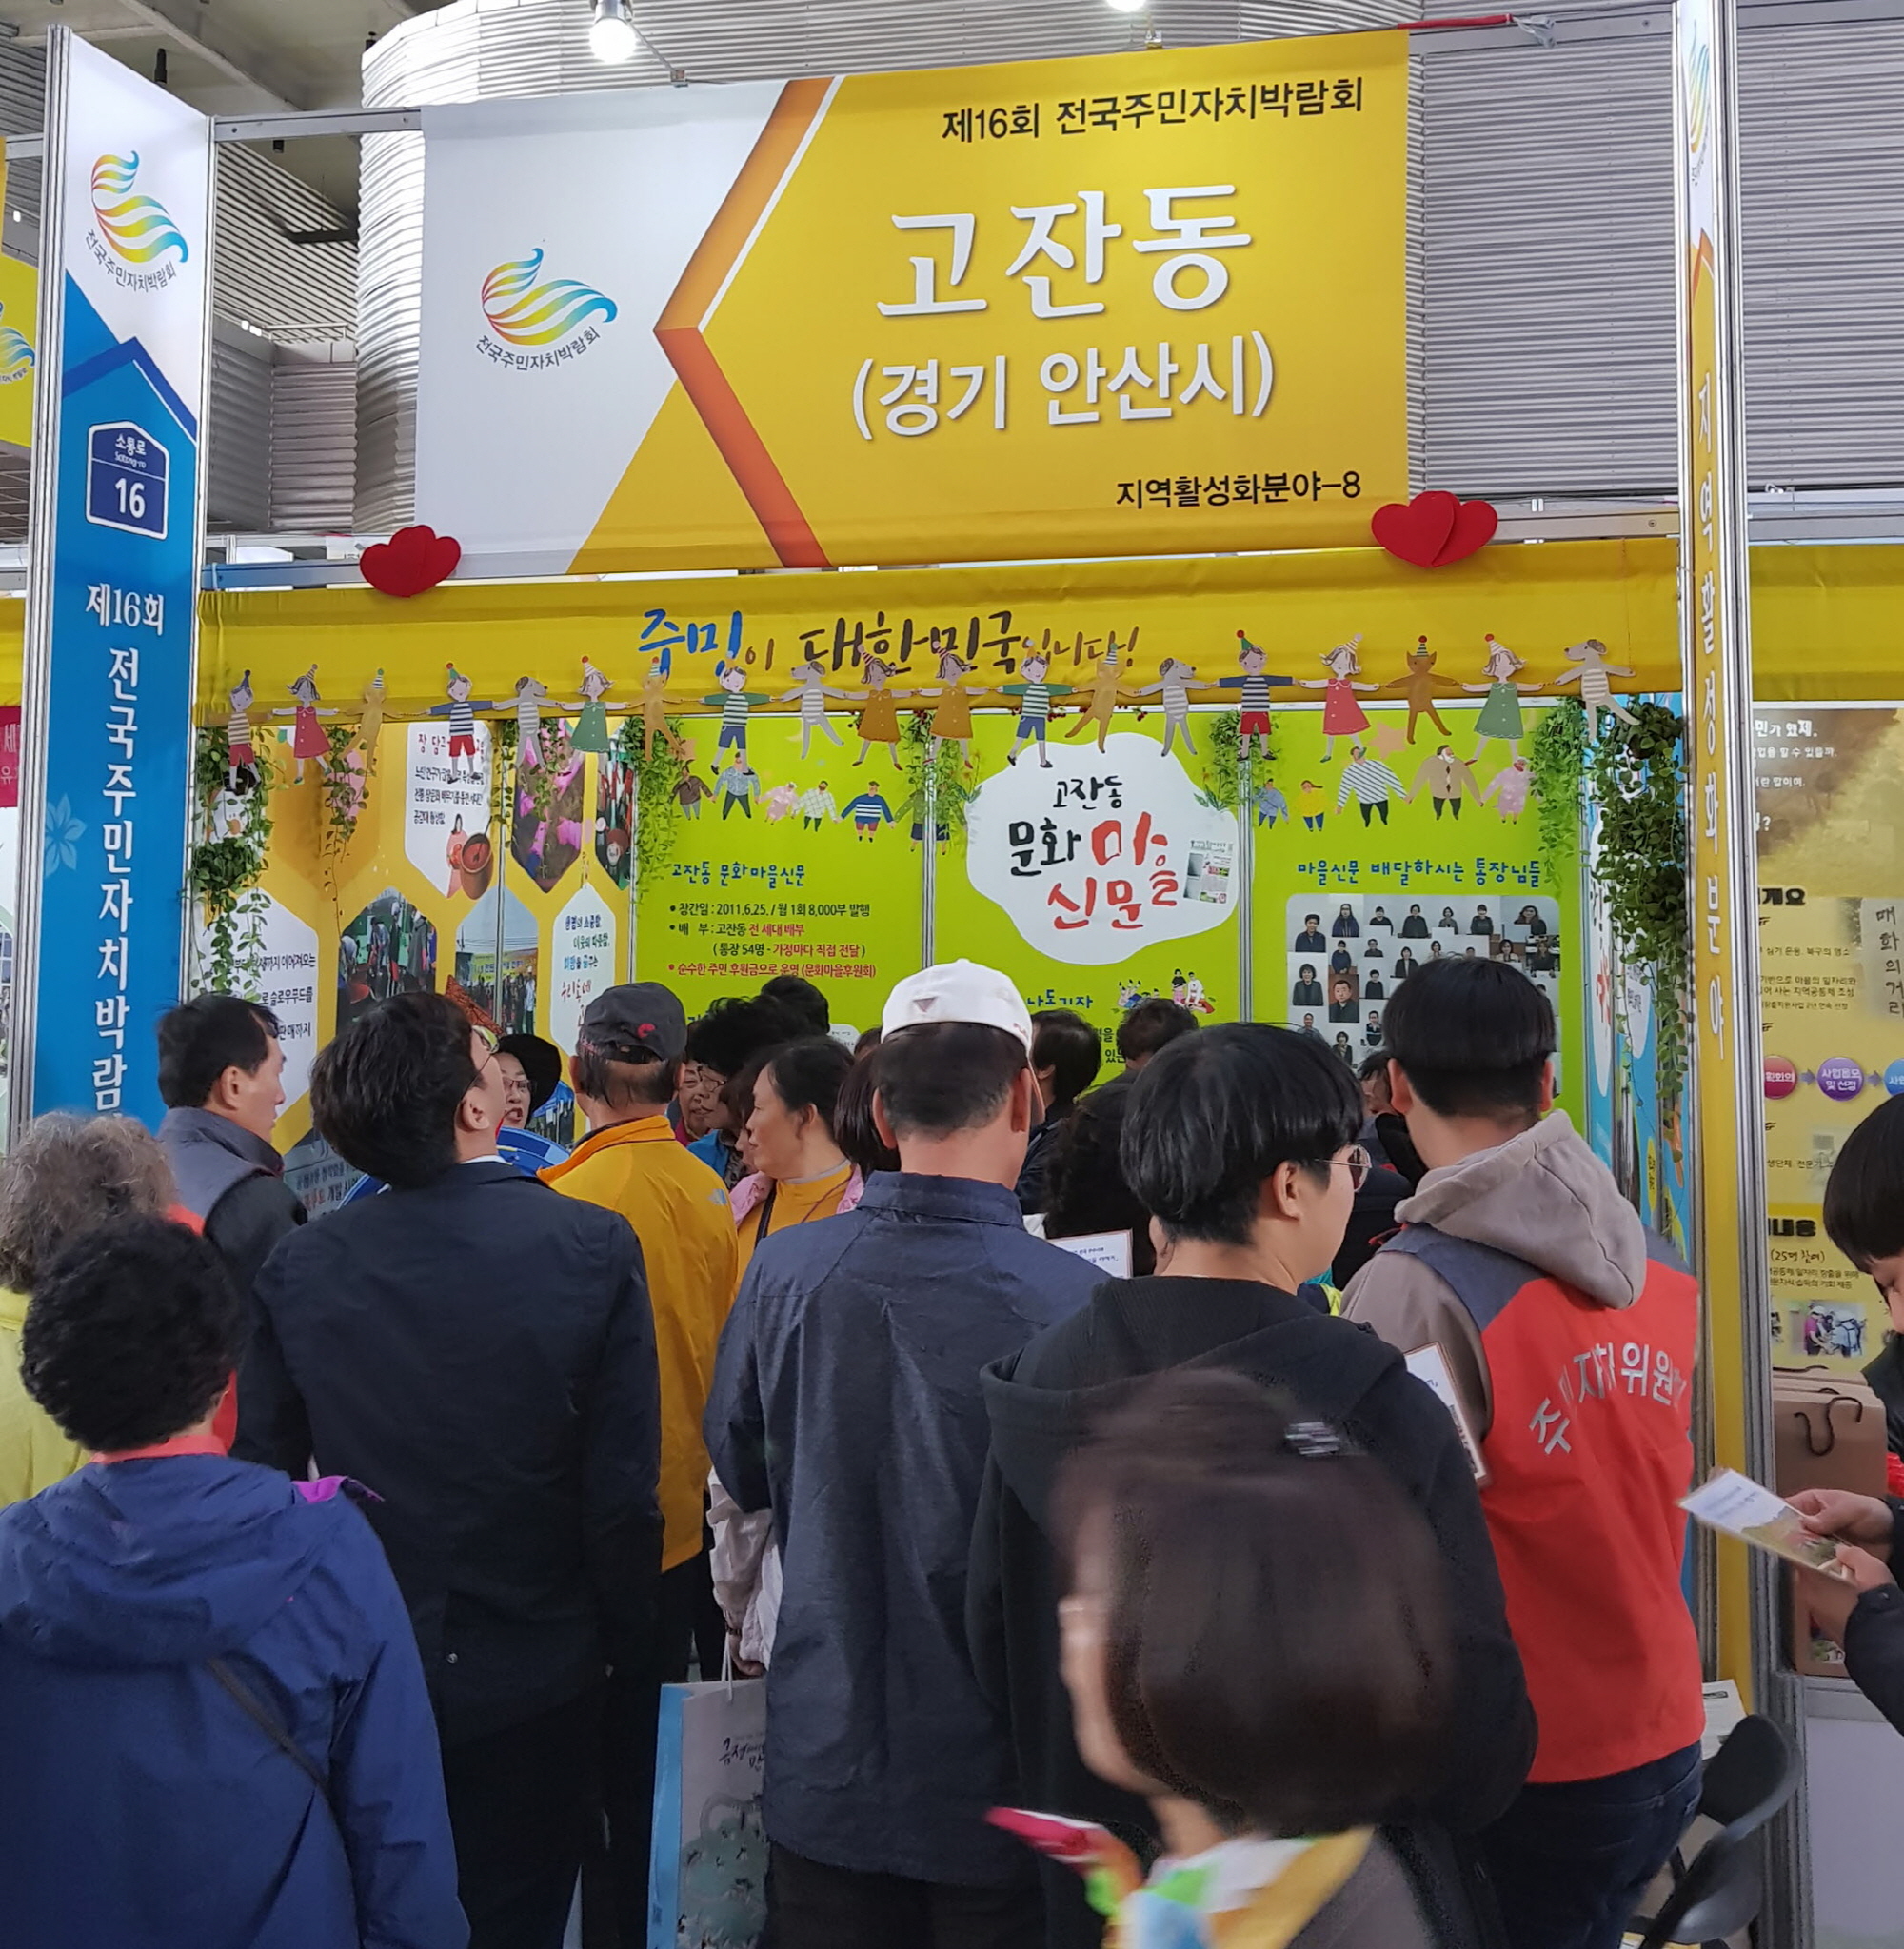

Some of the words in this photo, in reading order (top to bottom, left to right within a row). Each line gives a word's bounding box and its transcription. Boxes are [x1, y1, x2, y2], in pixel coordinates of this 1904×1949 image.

[942, 102, 1041, 143] 제16회
[1056, 76, 1364, 135] 전국주민자치박람회
[86, 228, 178, 293] 전국주민자치박람회
[876, 183, 1252, 319] 고잔동
[476, 325, 601, 371] 전국주민자치박람회
[852, 356, 1007, 441] (경기
[1039, 329, 1275, 427] 안산시)
[114, 433, 147, 456] 소통로
[114, 477, 146, 519] 16
[1116, 470, 1362, 510] 지역활성화분야-8
[85, 582, 165, 637] 제16회
[1052, 774, 1124, 810] 고잔동
[671, 861, 711, 885] 고잔동
[720, 861, 805, 889] 문화마을신문
[1007, 816, 1083, 877] 문화
[1090, 810, 1180, 907] 마을
[1298, 860, 1359, 886] 마을신문
[1371, 859, 1464, 886] 배달하시는
[1475, 858, 1541, 888] 통장님들
[91, 647, 140, 1118] 전국주민자치박람
[1046, 876, 1144, 930] 신문
[1758, 887, 1807, 906] 개요
[715, 923, 747, 937] 고잔동
[748, 923, 760, 937] 전
[762, 924, 783, 938] 세대
[784, 924, 805, 937] 배부
[791, 904, 806, 917] 1회
[808, 904, 846, 917] 8,000부
[708, 963, 728, 976] 주민
[742, 943, 764, 957] 54명
[772, 944, 814, 958] 가정마다
